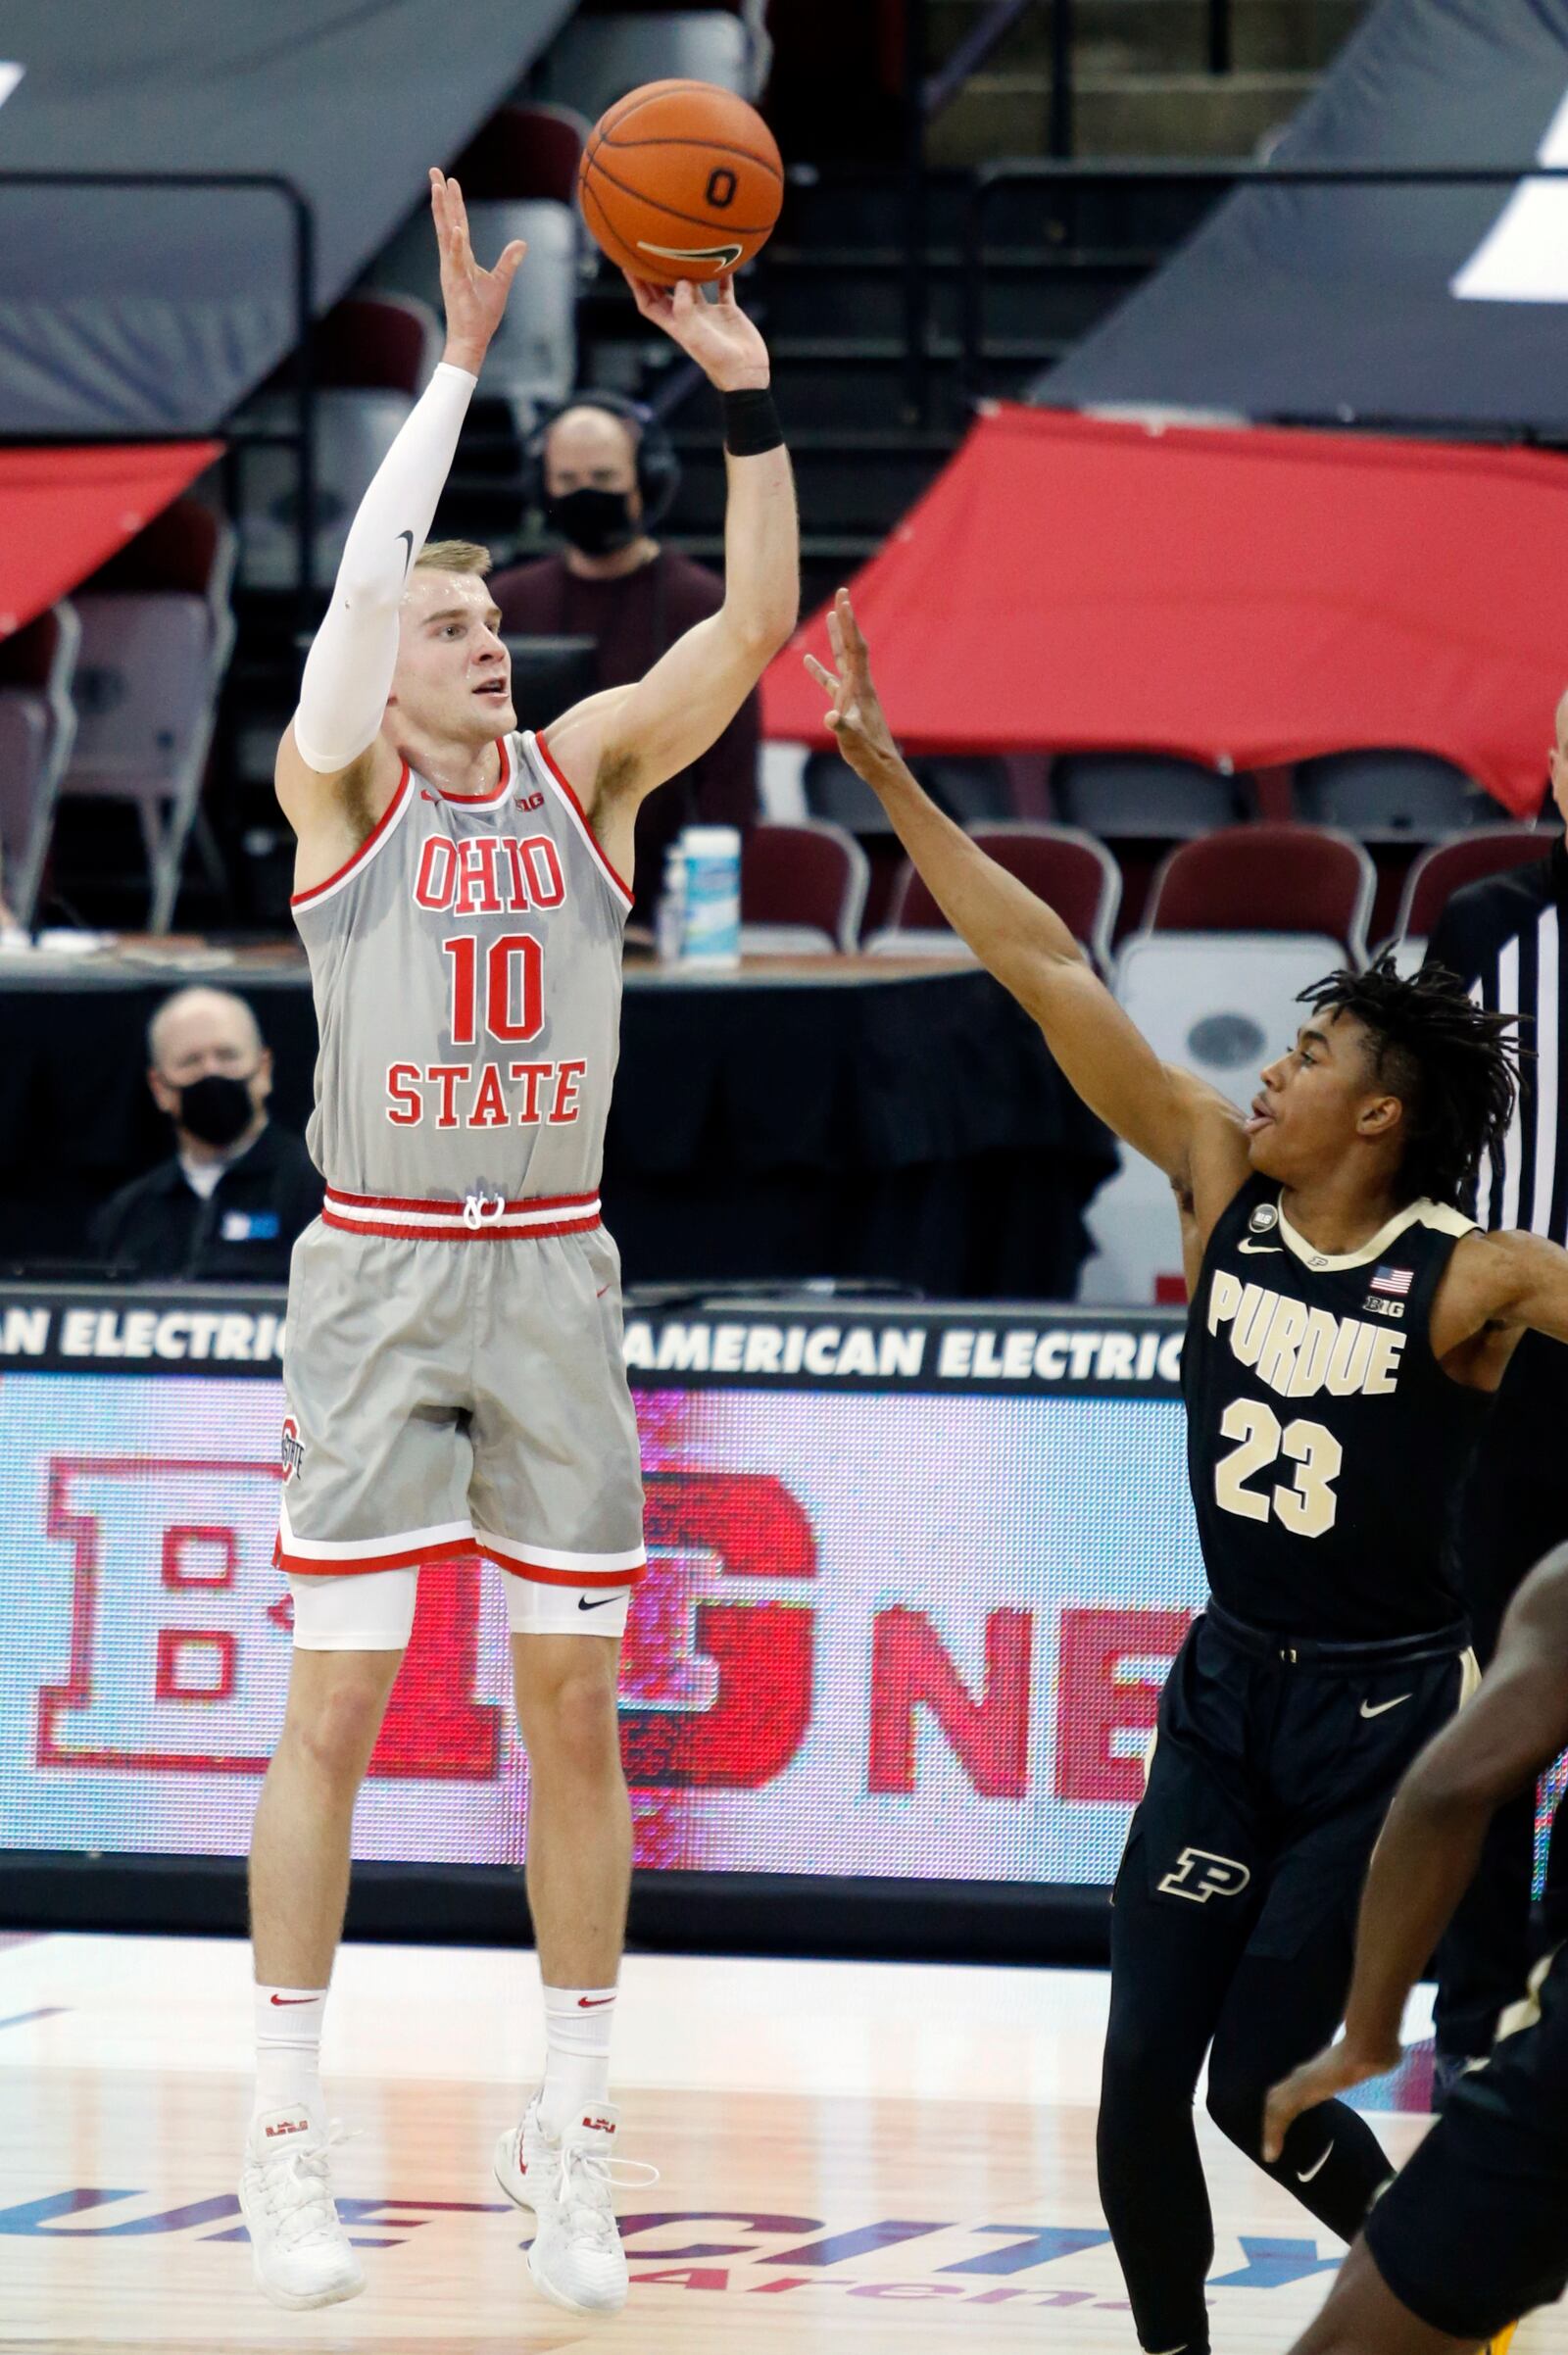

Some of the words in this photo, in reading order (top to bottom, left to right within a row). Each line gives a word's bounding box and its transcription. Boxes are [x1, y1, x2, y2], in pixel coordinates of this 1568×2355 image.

[413, 833, 567, 917] OHIO
[442, 933, 545, 1046] 10
[386, 1058, 588, 1130] STATE
[1207, 1269, 1407, 1398] PURDUE
[1362, 1295, 1405, 1318] BIG
[622, 1323, 927, 1376] AMERICAN
[1215, 1398, 1343, 1538] 23
[1157, 1847, 1250, 1903] P
